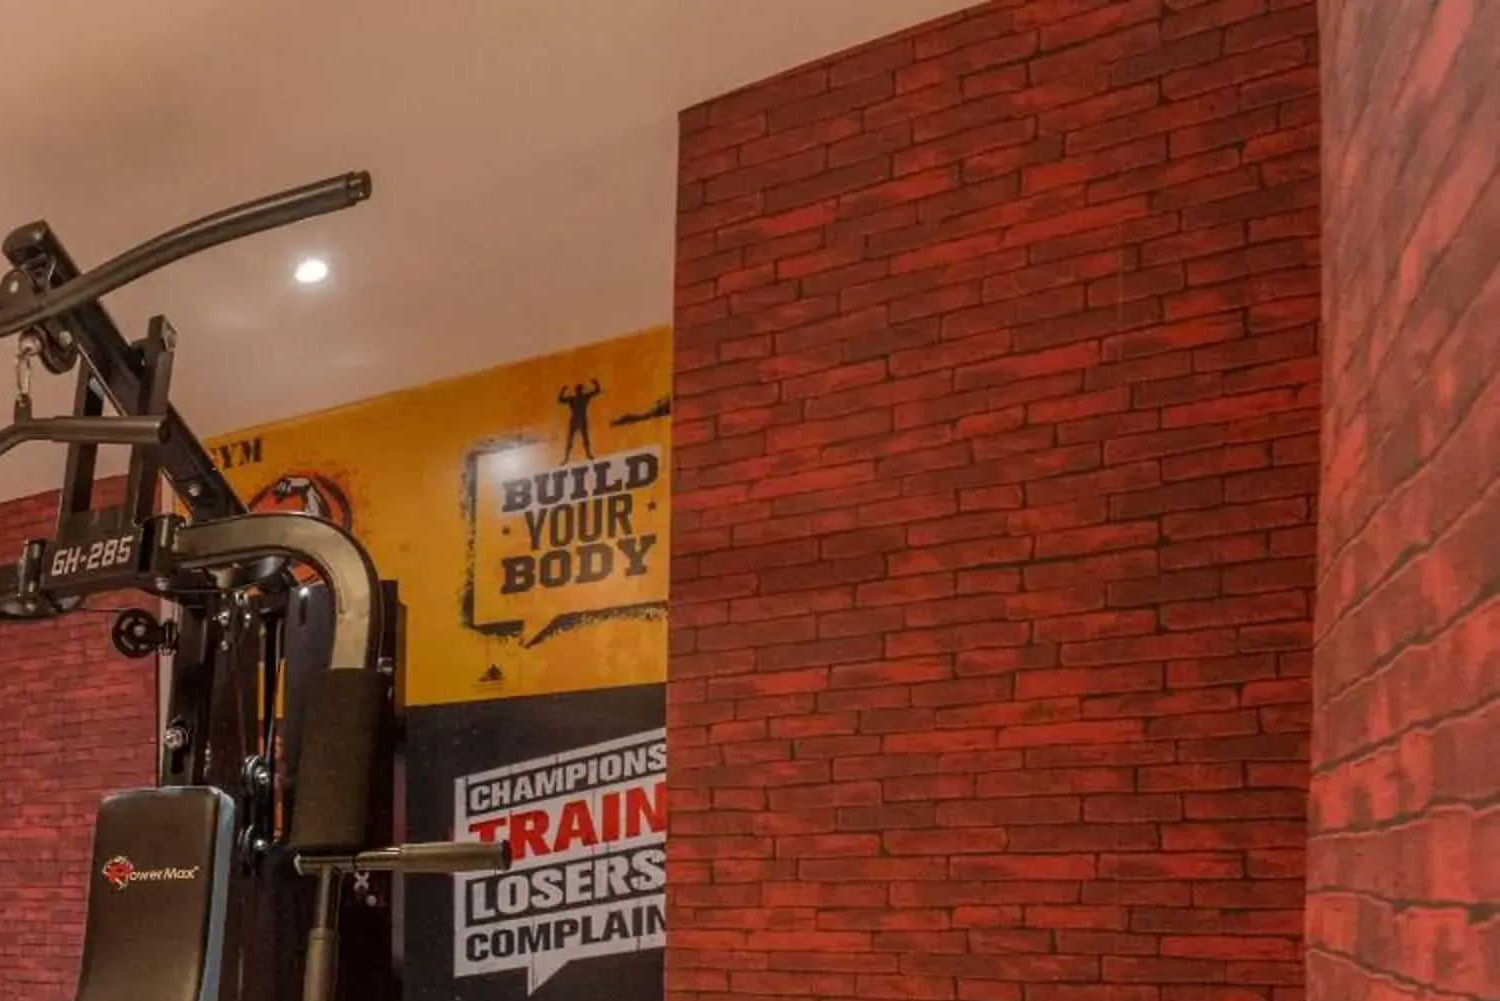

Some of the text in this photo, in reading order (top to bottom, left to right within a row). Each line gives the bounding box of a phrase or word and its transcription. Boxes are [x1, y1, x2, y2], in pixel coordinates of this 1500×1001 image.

[210, 437, 262, 468] YM
[501, 453, 659, 512] BUILD
[524, 493, 633, 551] YOUR
[51, 535, 134, 577] GH-285
[501, 533, 657, 594] BODY
[468, 743, 666, 811] CHAMPIONS
[468, 781, 666, 861] TRAIN
[472, 849, 666, 921] LOSERS
[466, 904, 666, 962] COMPLAIN
